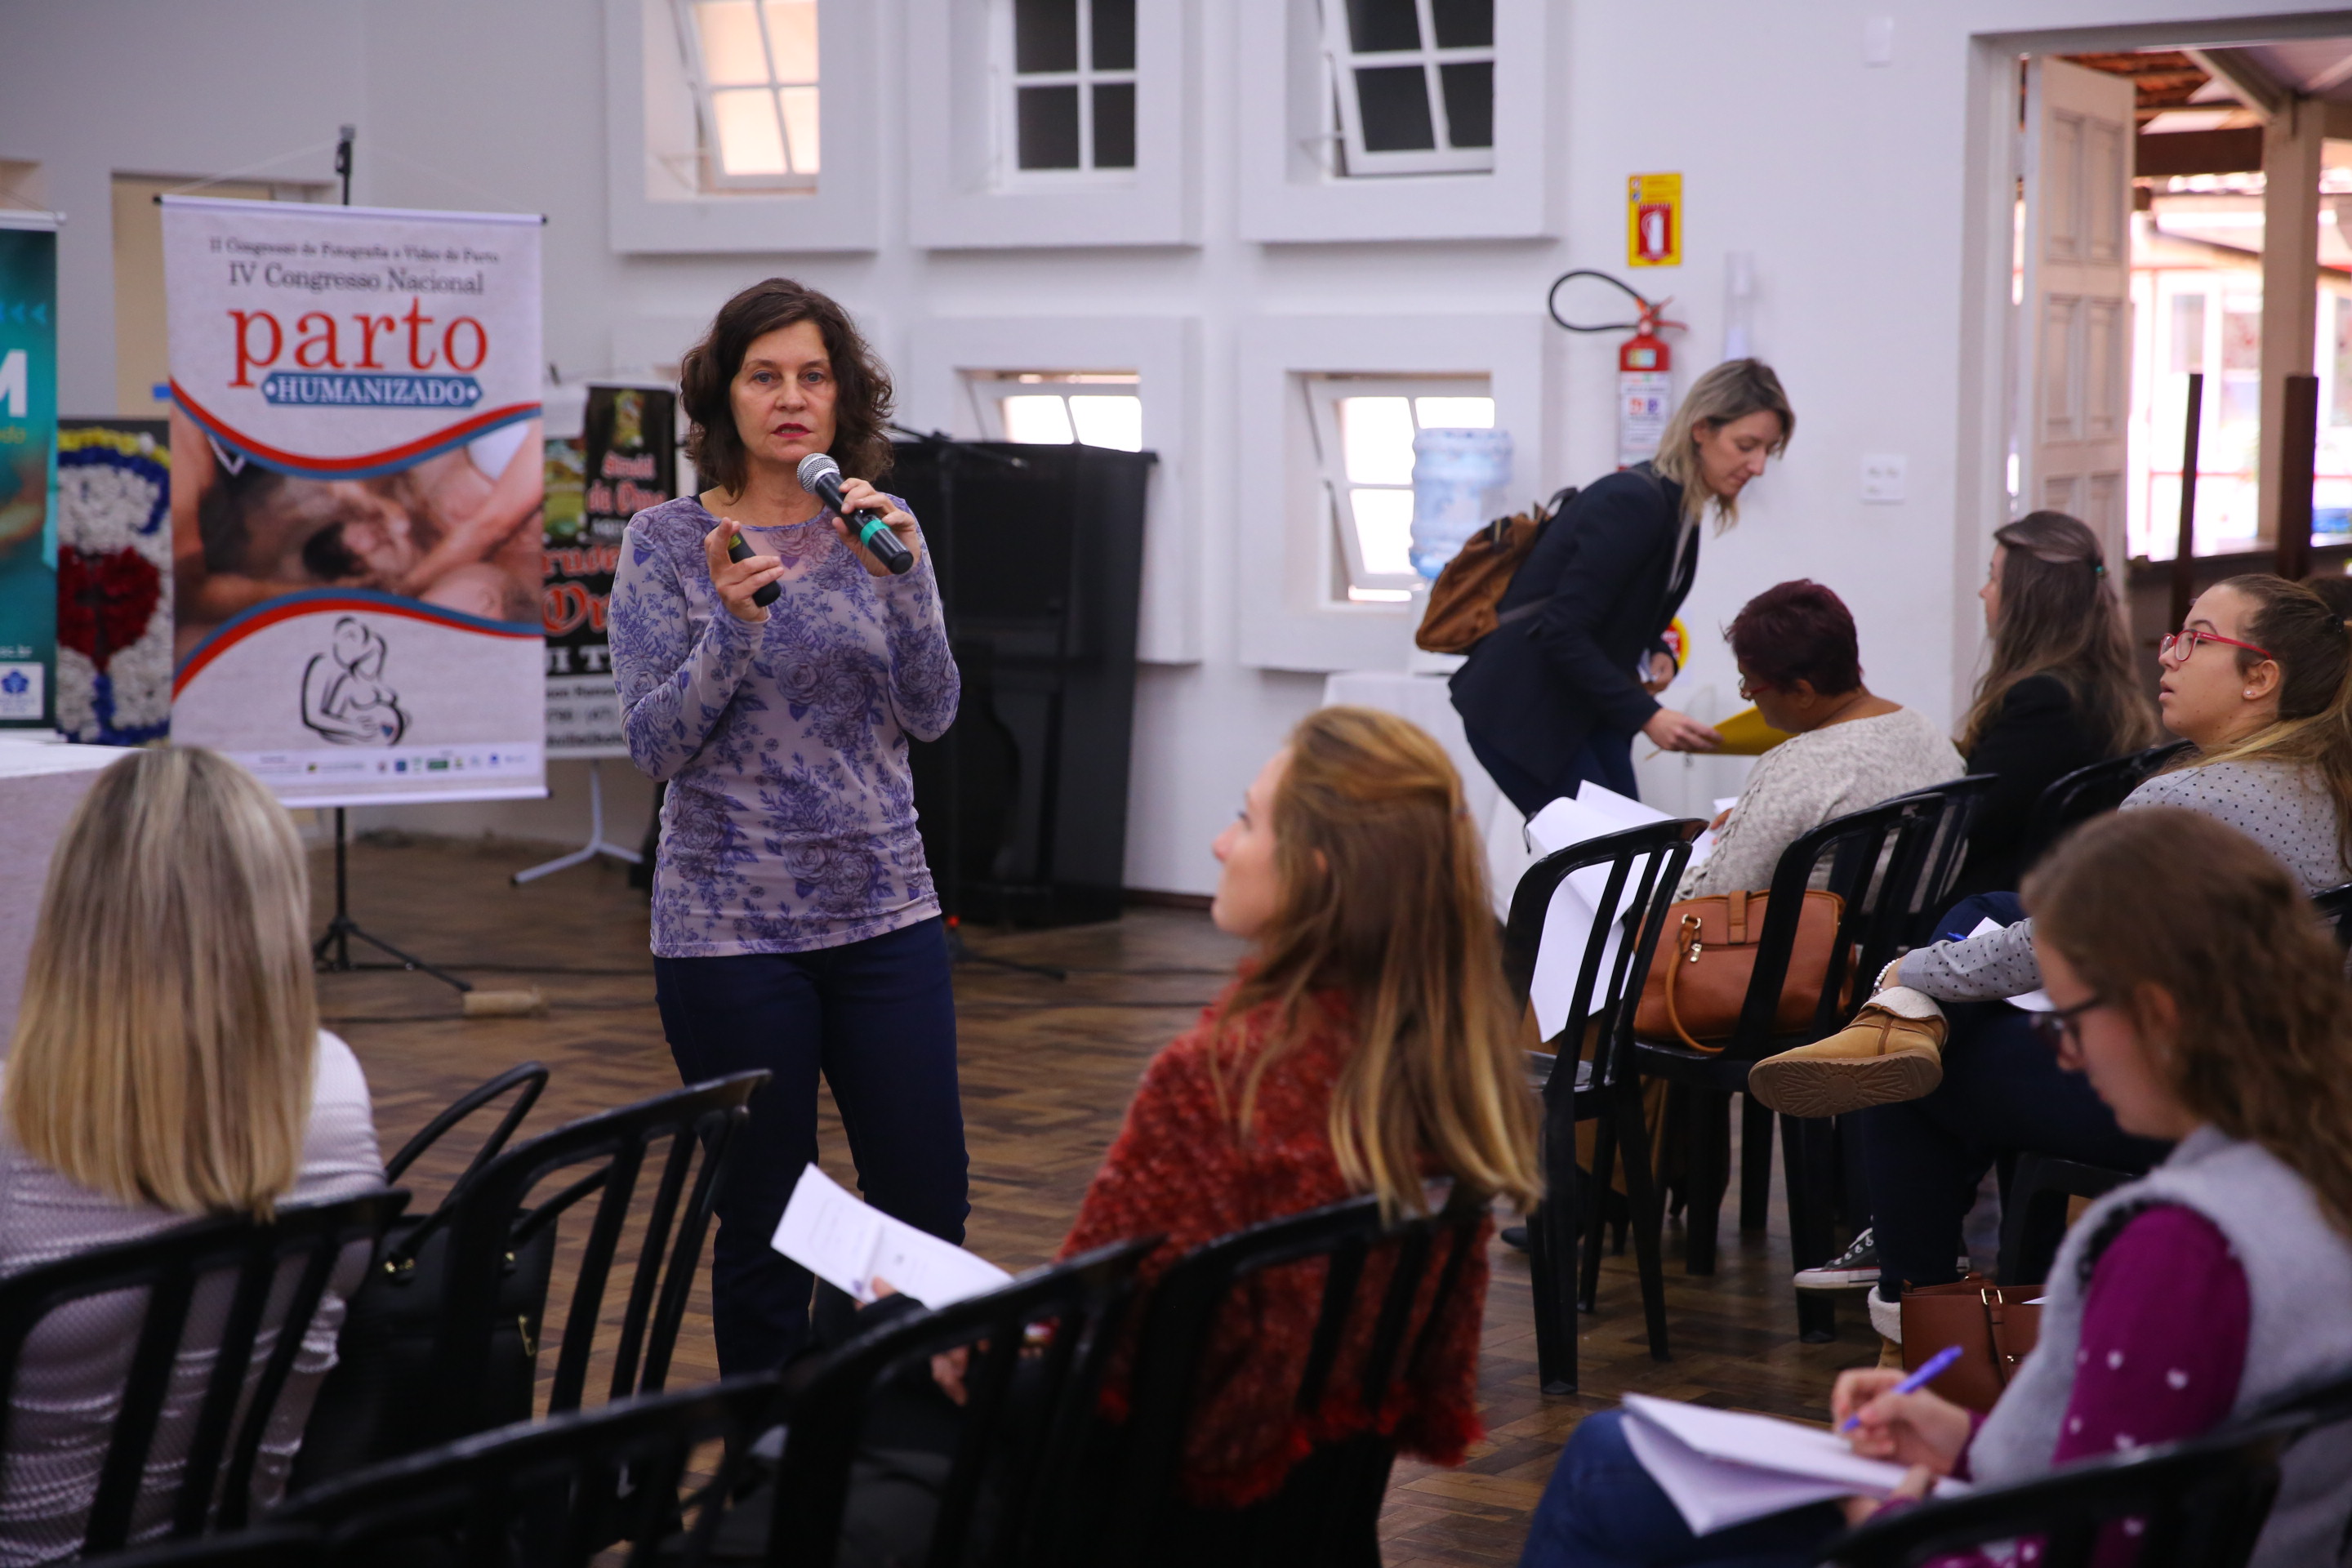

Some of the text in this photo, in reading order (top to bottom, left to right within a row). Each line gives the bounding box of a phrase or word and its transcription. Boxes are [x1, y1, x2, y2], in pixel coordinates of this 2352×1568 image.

[229, 260, 483, 296] IV Congresso Nacional
[227, 296, 488, 389] parto
[276, 376, 466, 405] HUMANIZADO
